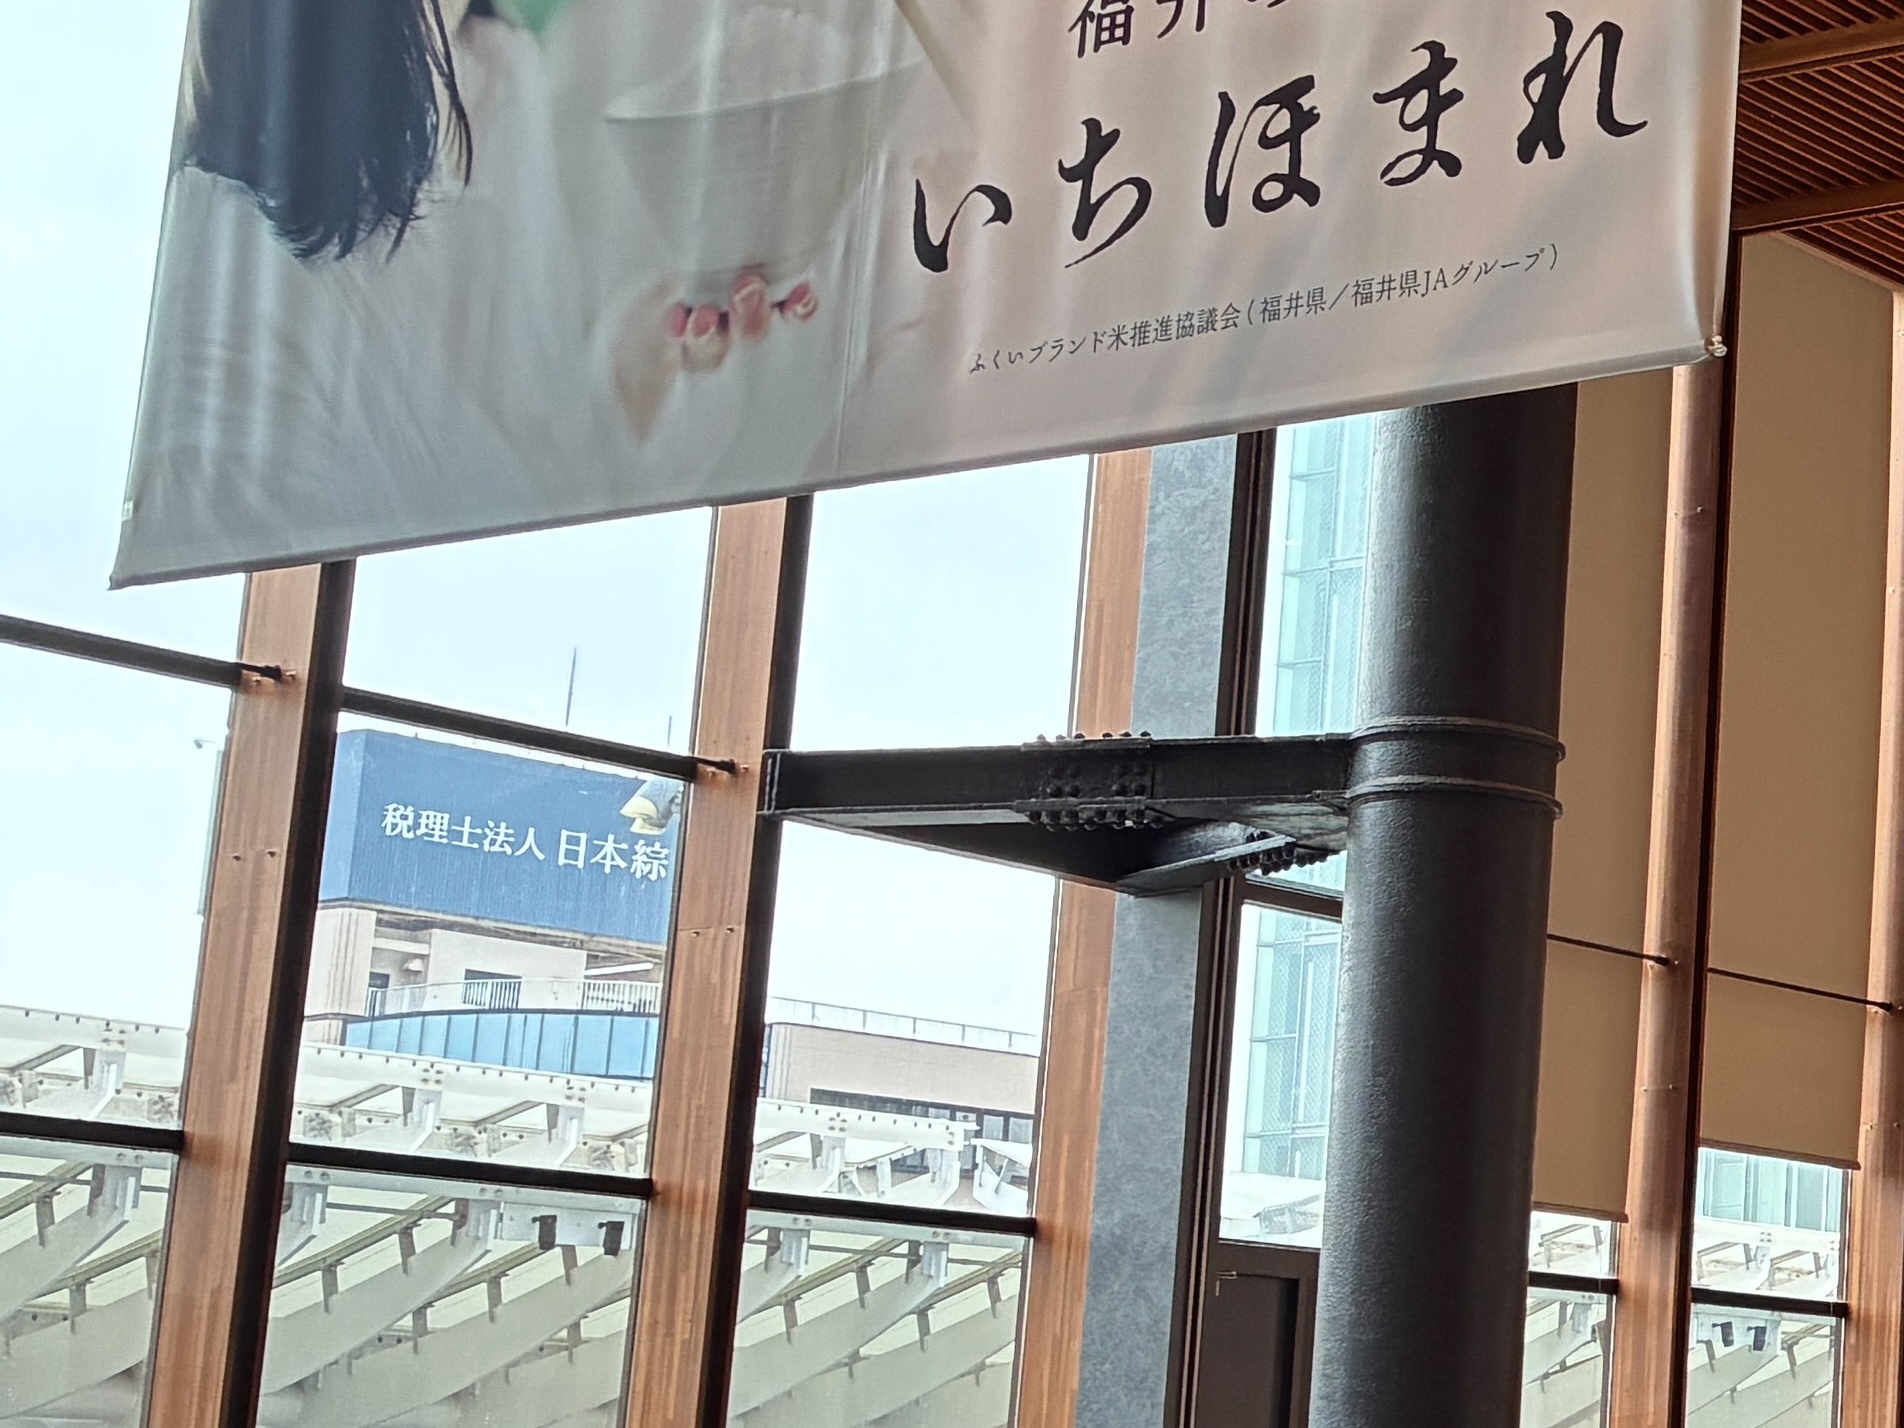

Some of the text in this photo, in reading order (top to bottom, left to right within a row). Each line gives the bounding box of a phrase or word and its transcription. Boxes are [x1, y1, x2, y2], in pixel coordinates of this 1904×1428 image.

[912, 10, 1649, 274] いちほまれ
[381, 801, 670, 882] 税理士法人 日本綜
